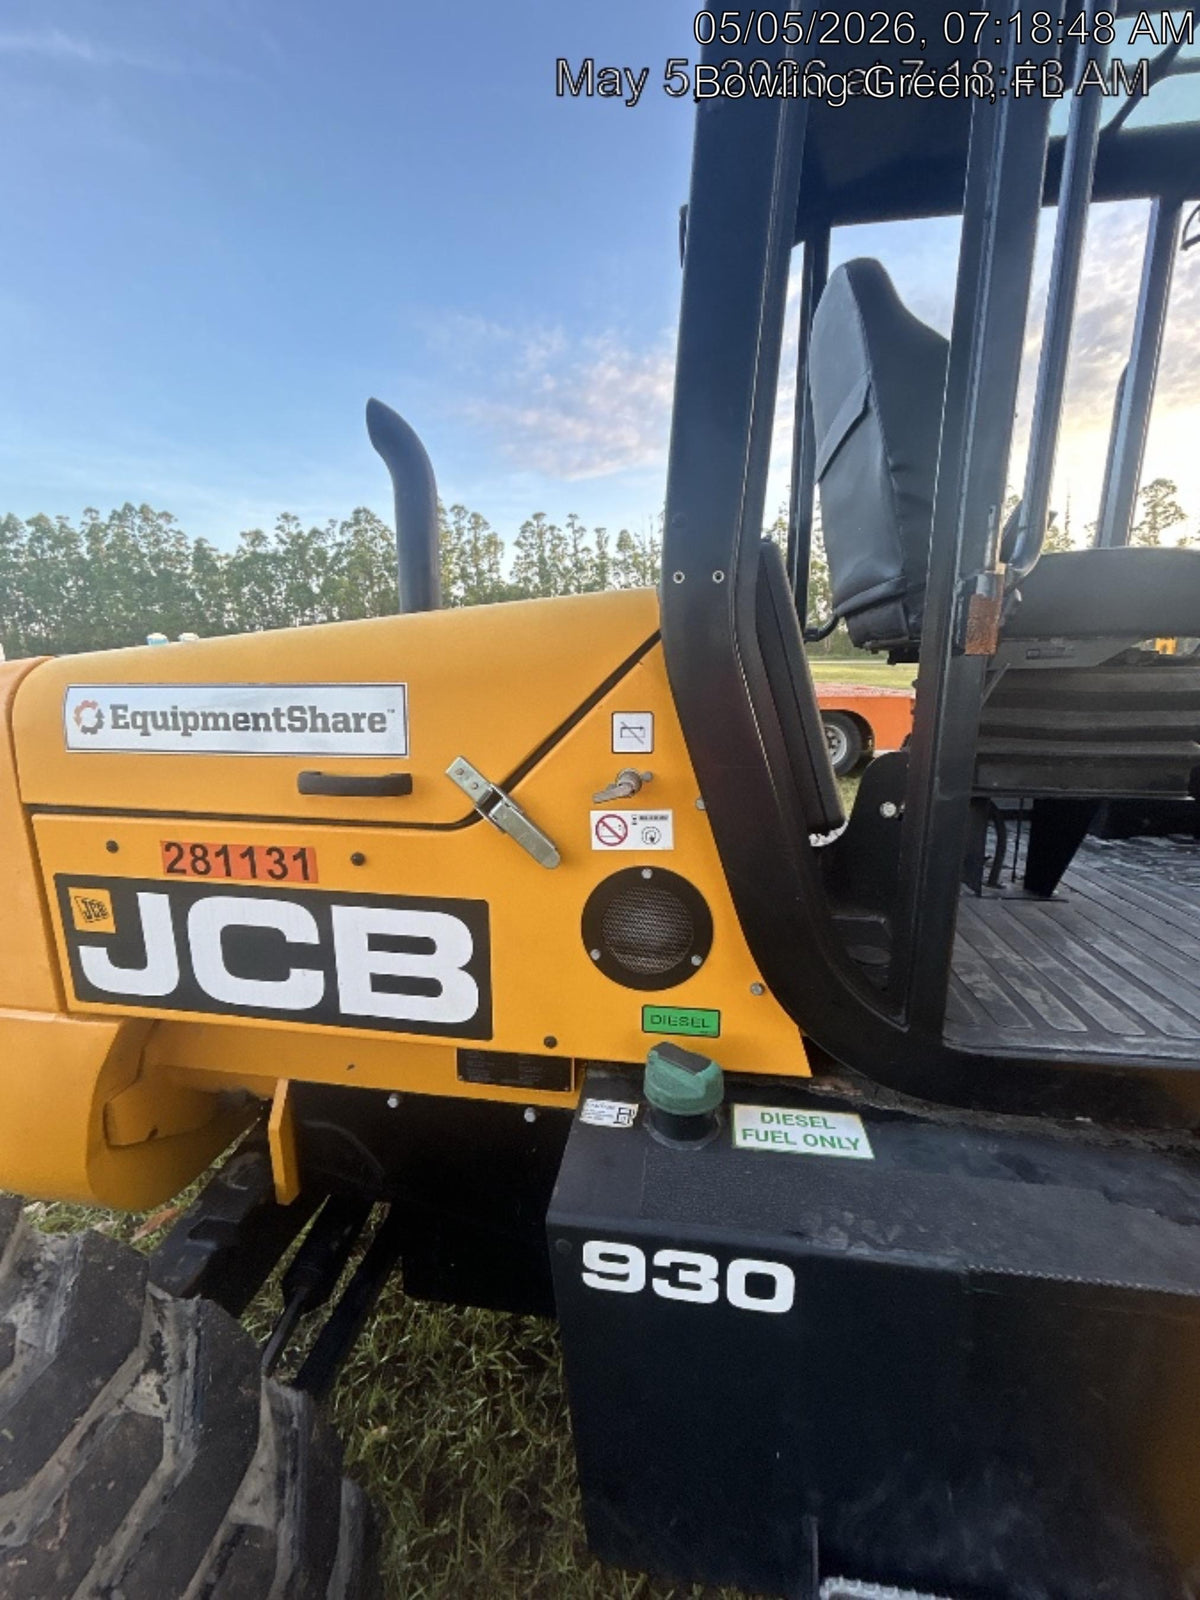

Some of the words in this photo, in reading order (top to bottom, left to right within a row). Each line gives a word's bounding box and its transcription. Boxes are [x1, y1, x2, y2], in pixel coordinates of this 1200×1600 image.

[109, 703, 388, 737] EquipmentShare
[163, 841, 311, 881] 281131
[78, 891, 479, 1024] JCB
[650, 1014, 711, 1028] DIESEL
[760, 1111, 837, 1130] DIESEL
[742, 1128, 797, 1146] FUEL
[803, 1133, 860, 1151] ONLY
[581, 1240, 796, 1313] 930
